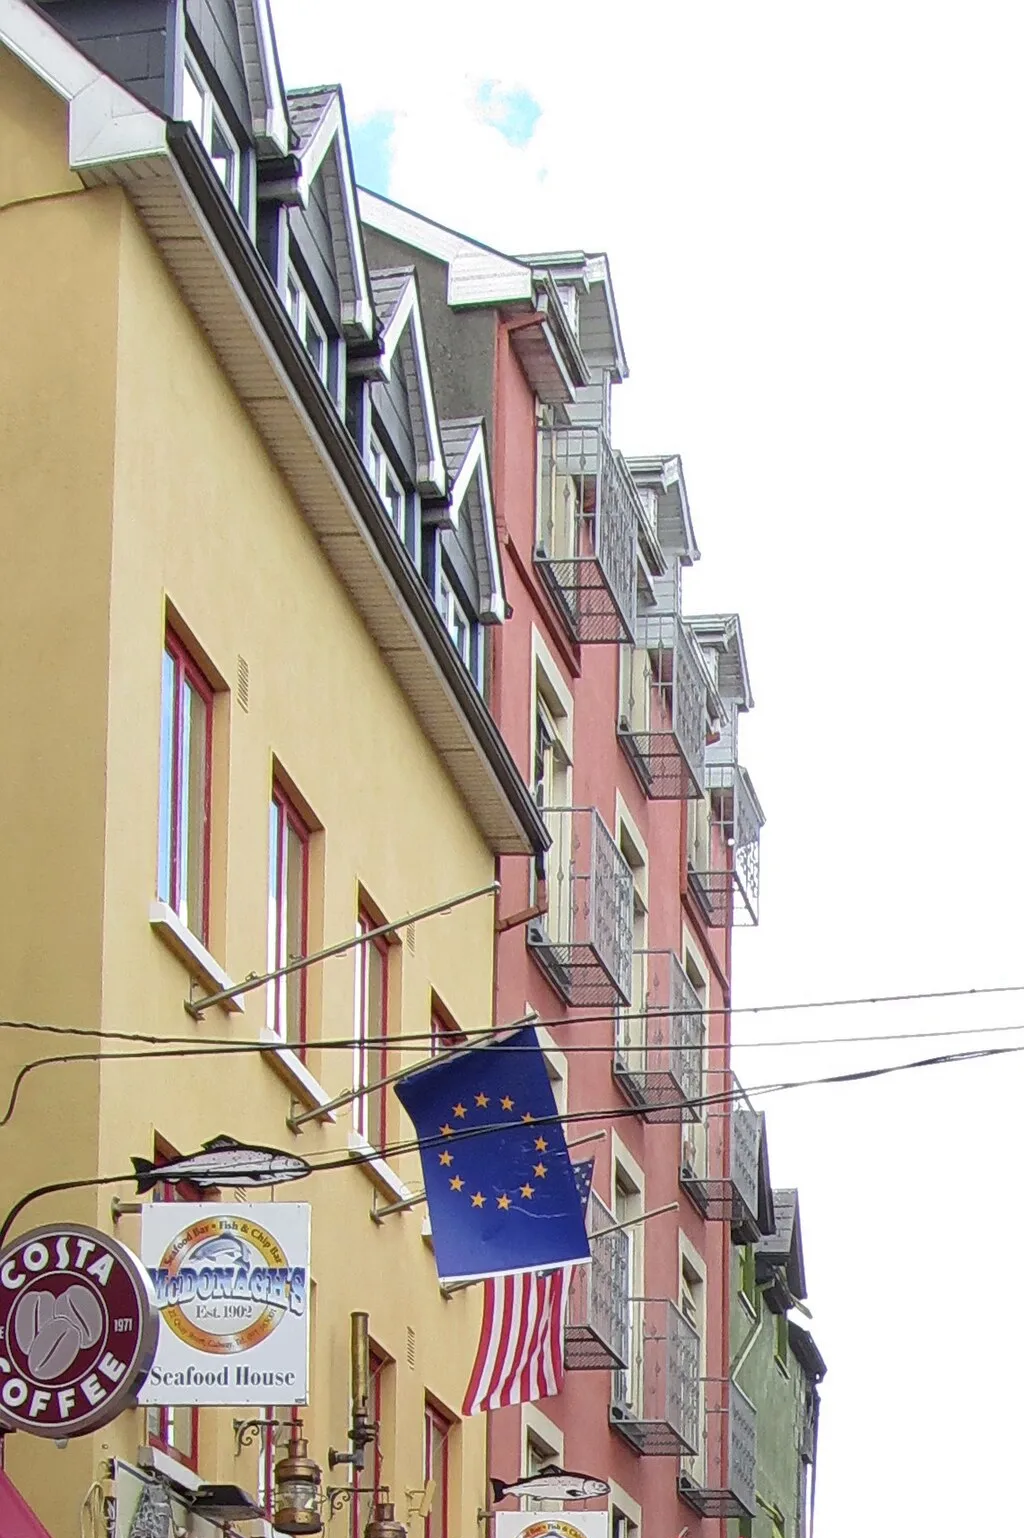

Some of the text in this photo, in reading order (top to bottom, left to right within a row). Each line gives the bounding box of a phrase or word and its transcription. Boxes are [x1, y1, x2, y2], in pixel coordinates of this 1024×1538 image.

[164, 1221, 283, 1266] Seafood Bar Fish & Chip Bar
[1, 1237, 114, 1289] COSTA
[196, 1306, 252, 1318] Est. 1902
[114, 1318, 133, 1332] 1971
[151, 1366, 296, 1386] Seafood House
